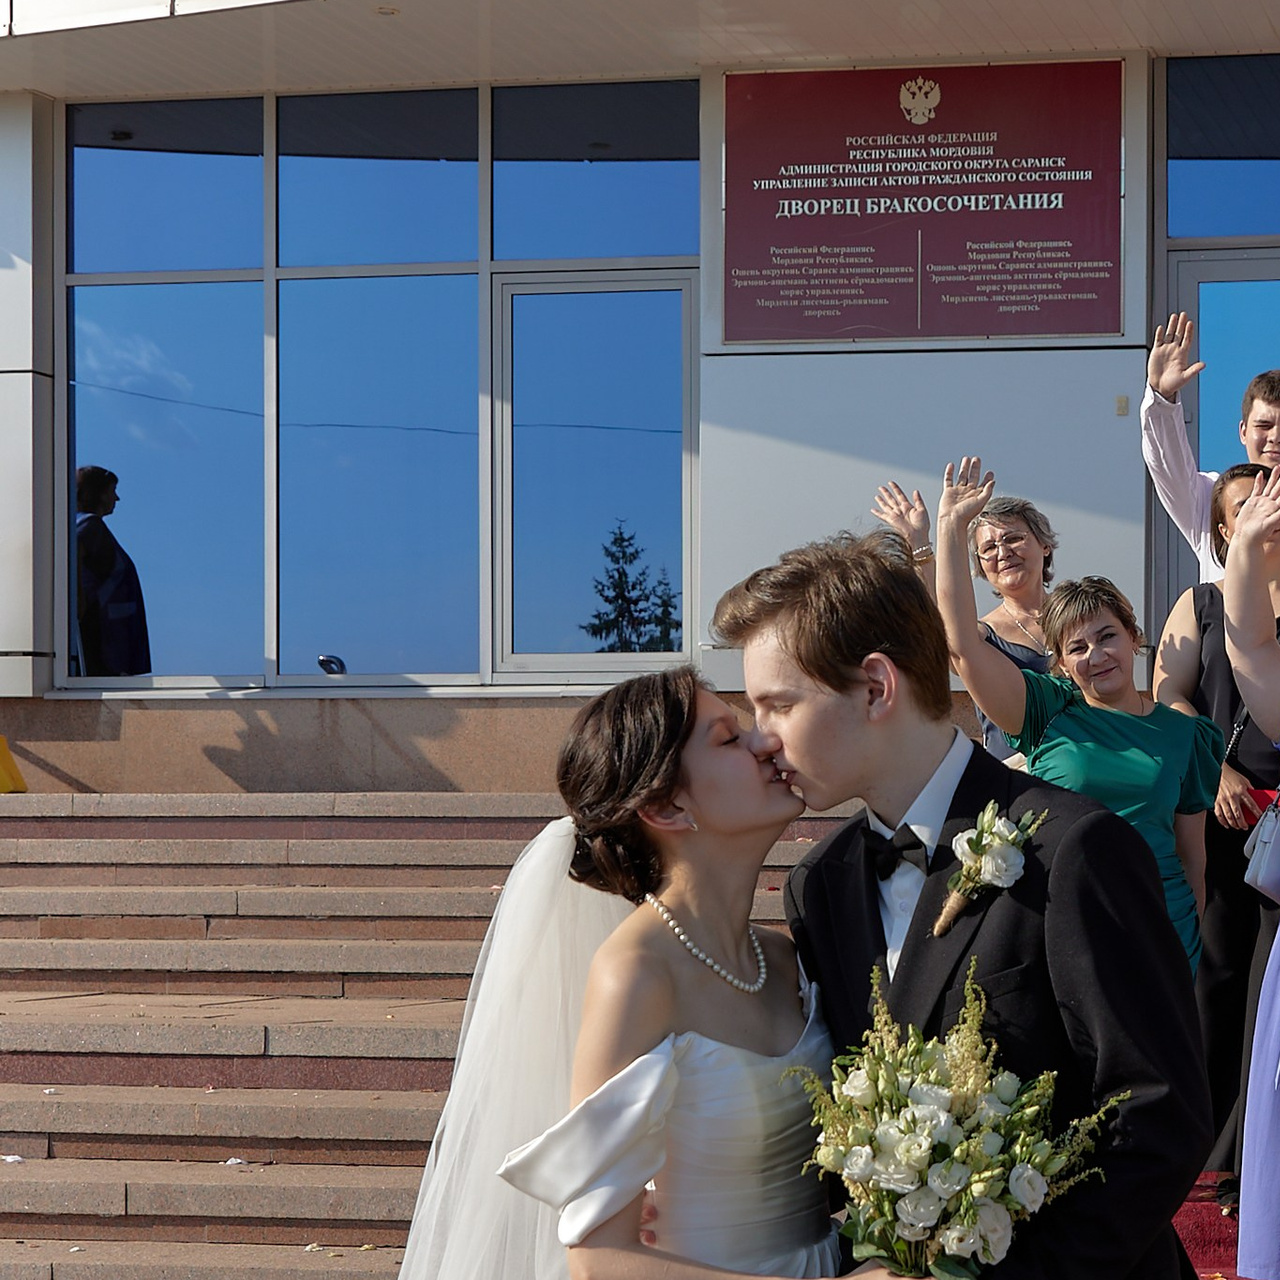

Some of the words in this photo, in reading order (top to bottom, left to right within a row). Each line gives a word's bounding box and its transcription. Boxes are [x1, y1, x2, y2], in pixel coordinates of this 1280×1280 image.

[846, 133, 926, 147] РОССИЙСКАЯ
[928, 131, 998, 144] ФЕДЕРАЦИЯ
[849, 147, 928, 160] РЕСПУБЛИКА
[930, 145, 994, 158] МОРДОВИЯ
[778, 161, 883, 176] АДМИНИСТРАЦИЯ
[886, 160, 963, 173] ГОРОДСКОГО
[964, 158, 1010, 171] ОКРУГА
[1012, 156, 1066, 169] САРАНСК
[753, 176, 828, 190] УПРАВЛЕНИЕ
[830, 176, 878, 188] ЗАПИСИ
[880, 175, 920, 186] АКТОВ
[922, 172, 1016, 186] ГРАЖДАНСКОГО
[1018, 170, 1093, 182] СОСТОЯНИЯ
[776, 197, 861, 219] ДВОРЕЦ
[866, 192, 1064, 215] БРАКОСОЧЕТАНИЯ
[966, 240, 1014, 250] Российской
[772, 256, 814, 266] Мордовия
[968, 251, 1010, 262] Мордовия
[802, 266, 838, 278] Саранск
[998, 261, 1035, 272] Саранск
